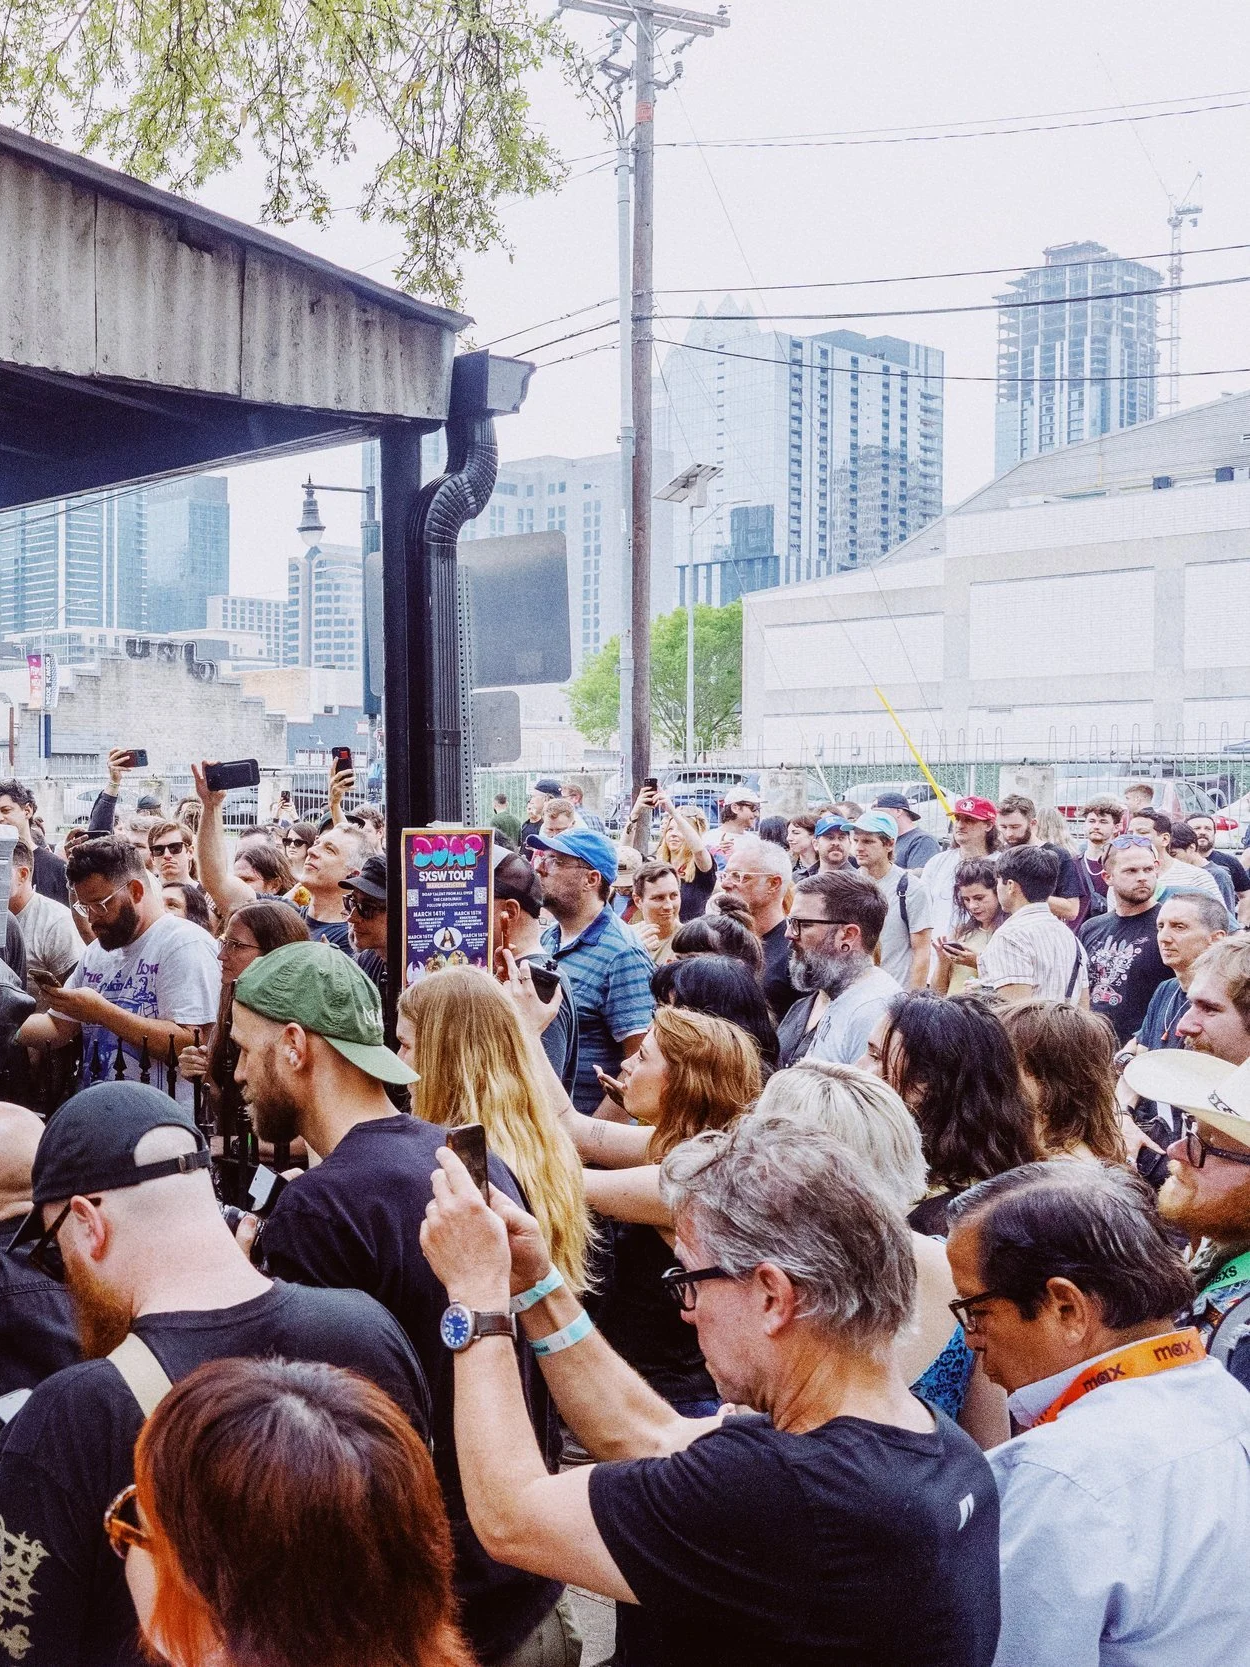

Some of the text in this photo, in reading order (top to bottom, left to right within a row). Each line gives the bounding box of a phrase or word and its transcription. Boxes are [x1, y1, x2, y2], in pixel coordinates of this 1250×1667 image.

[418, 870, 474, 881] SXSW TOUR
[1211, 1265, 1238, 1285] SXS
[1153, 1338, 1194, 1362] max
[1082, 1362, 1126, 1393] max
